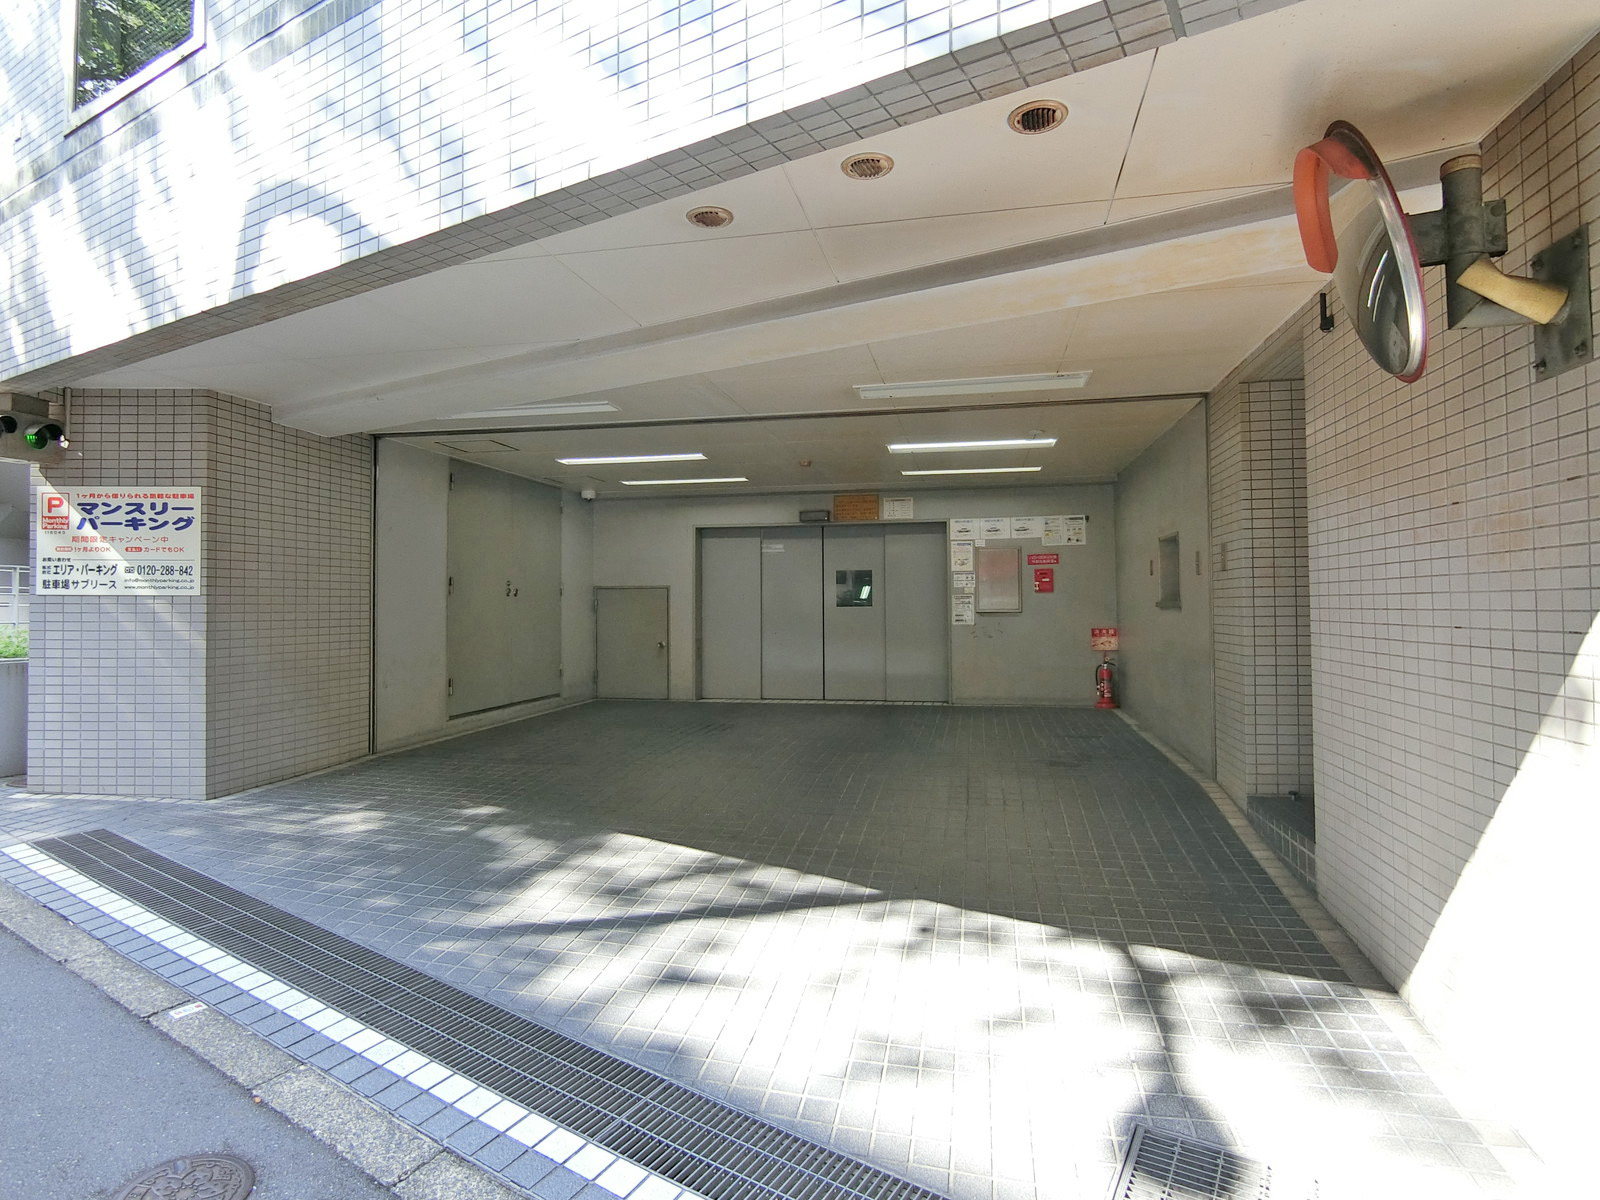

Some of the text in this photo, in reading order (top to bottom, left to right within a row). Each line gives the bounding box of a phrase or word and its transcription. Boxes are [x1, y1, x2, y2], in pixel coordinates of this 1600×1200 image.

[47, 497, 64, 514] P
[76, 502, 195, 516] マンスリー
[42, 517, 69, 525] Monthly
[76, 516, 195, 531] パーキング
[71, 535, 169, 544] 期間限定キャンペーン中
[136, 564, 194, 576] 0120-288-842
[42, 579, 117, 590] 駐車場サブリース
